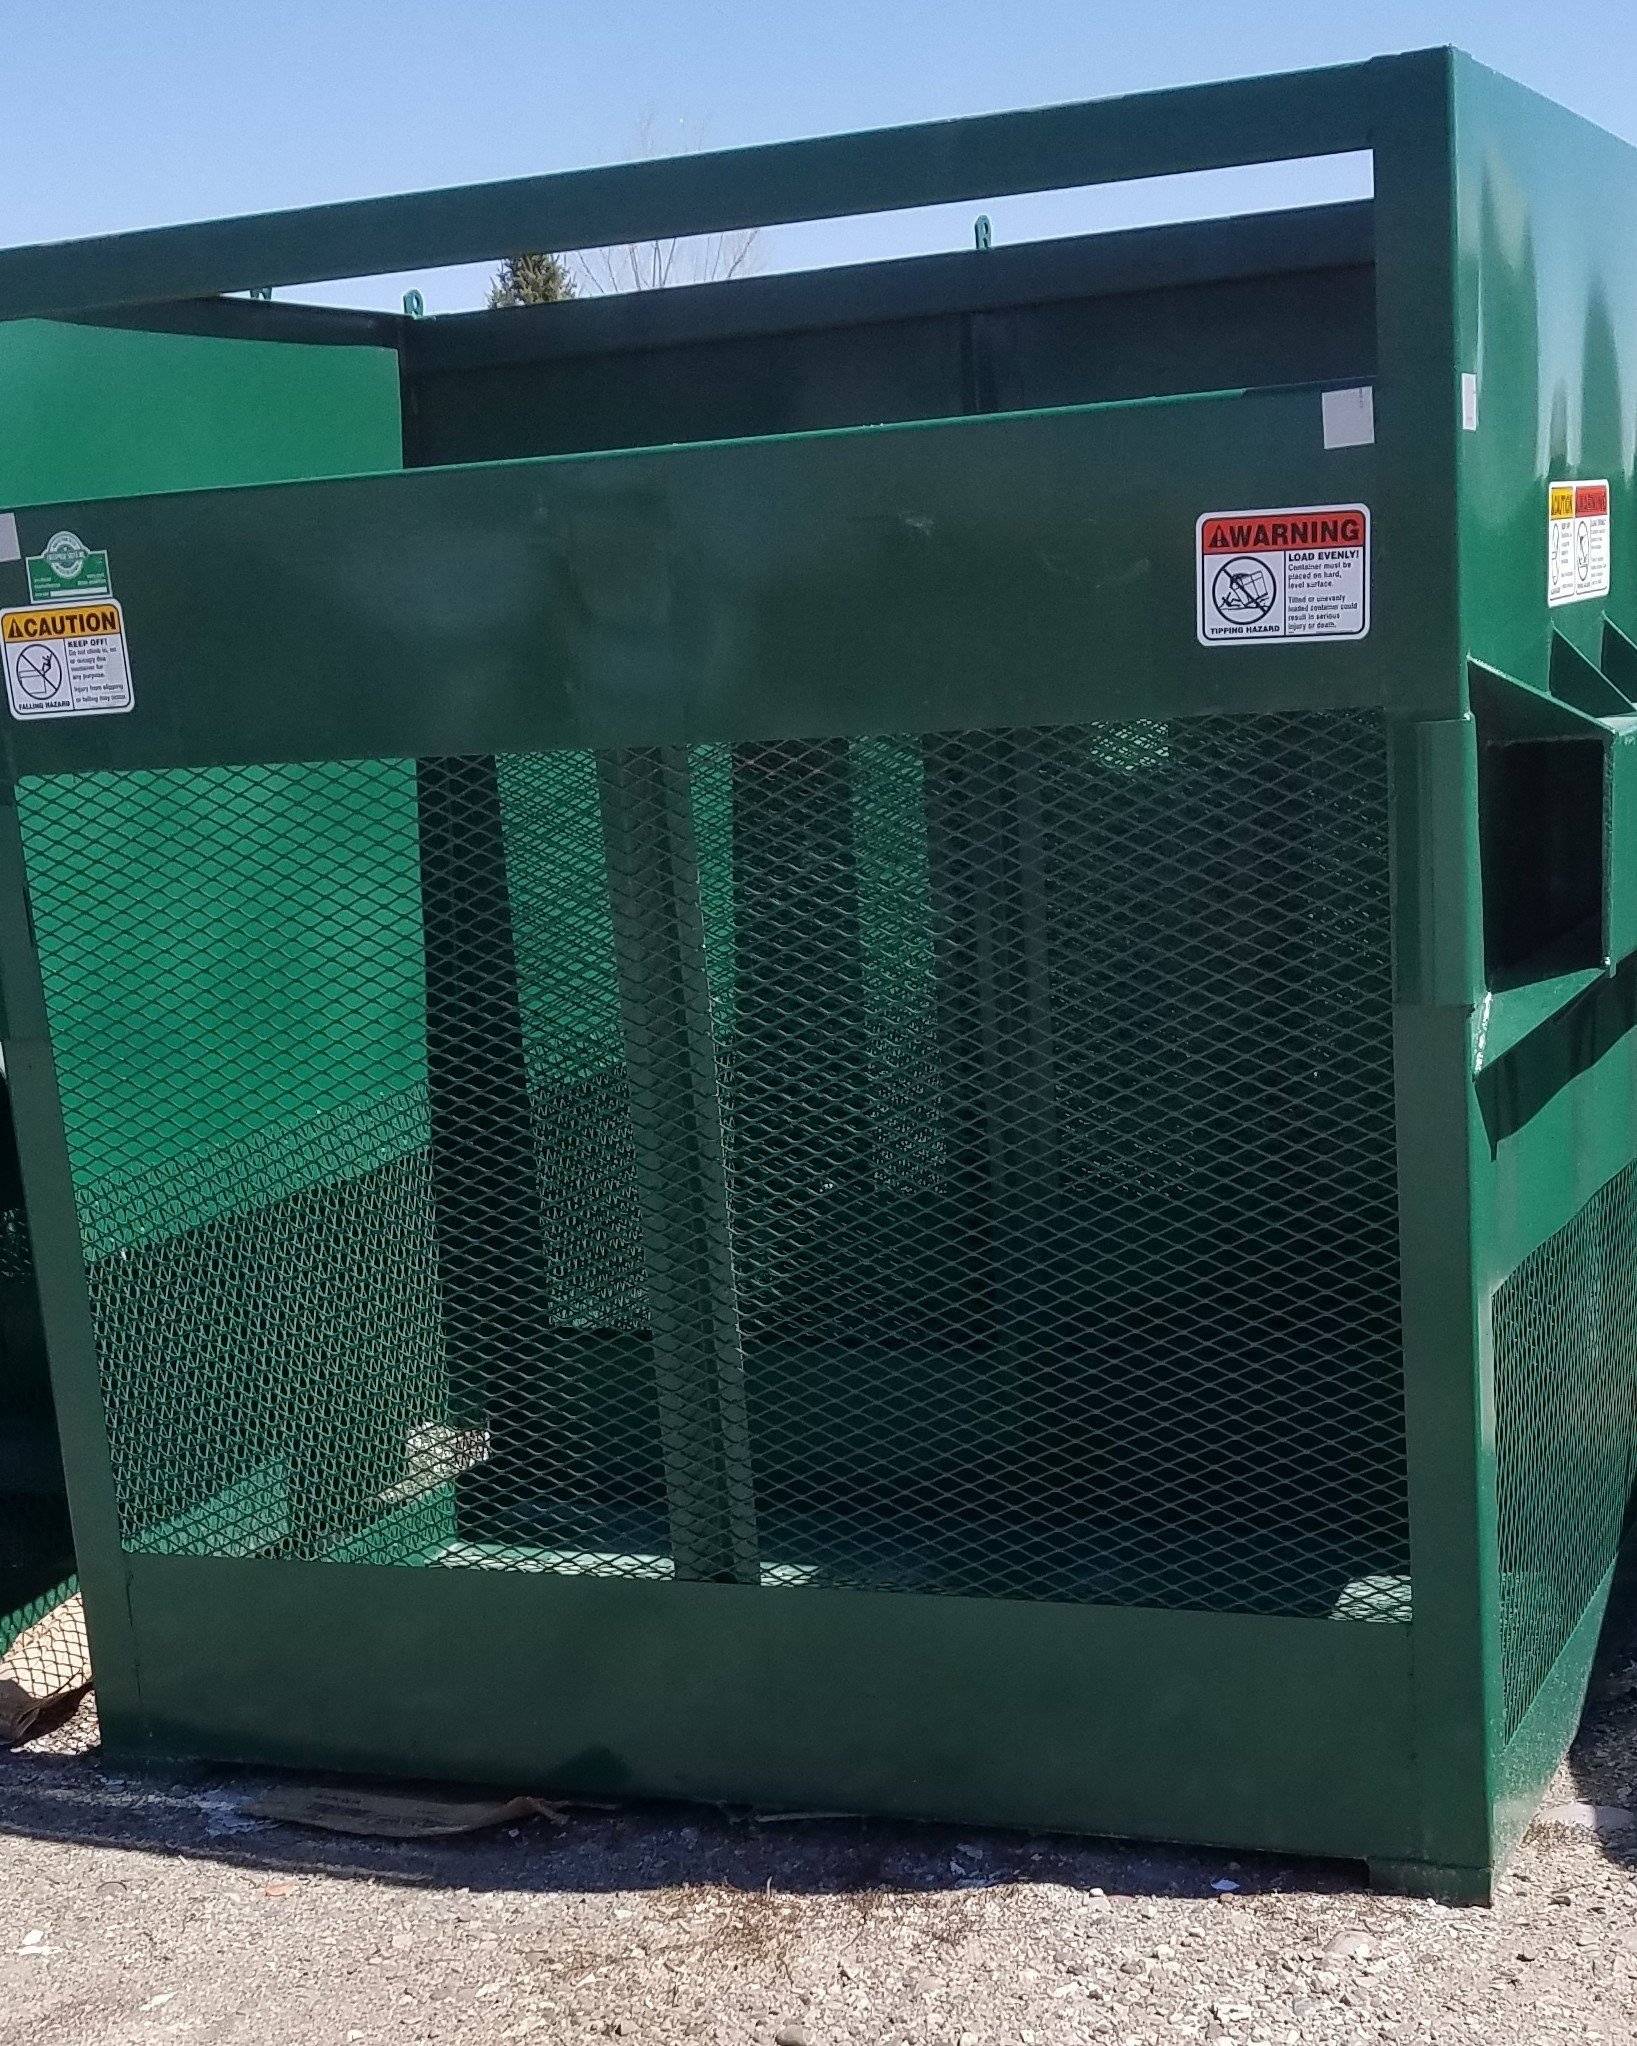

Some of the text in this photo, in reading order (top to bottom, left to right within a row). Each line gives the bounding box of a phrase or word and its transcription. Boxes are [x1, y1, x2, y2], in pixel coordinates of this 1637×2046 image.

[1230, 519, 1359, 547] WARNING
[1288, 550, 1359, 561] LOAD EVENLY!
[1288, 563, 1321, 571] Container
[1288, 572, 1311, 580] placed
[1324, 570, 1342, 578] hard,
[1288, 580, 1304, 589] level
[1317, 594, 1345, 603] unevenly
[1288, 604, 1308, 612] loaded
[1288, 613, 1306, 621] result
[24, 611, 117, 637] CAUTION
[1288, 622, 1306, 631] injury
[1210, 625, 1280, 635] TIPPING HAZARD
[90, 638, 107, 646] OFF!
